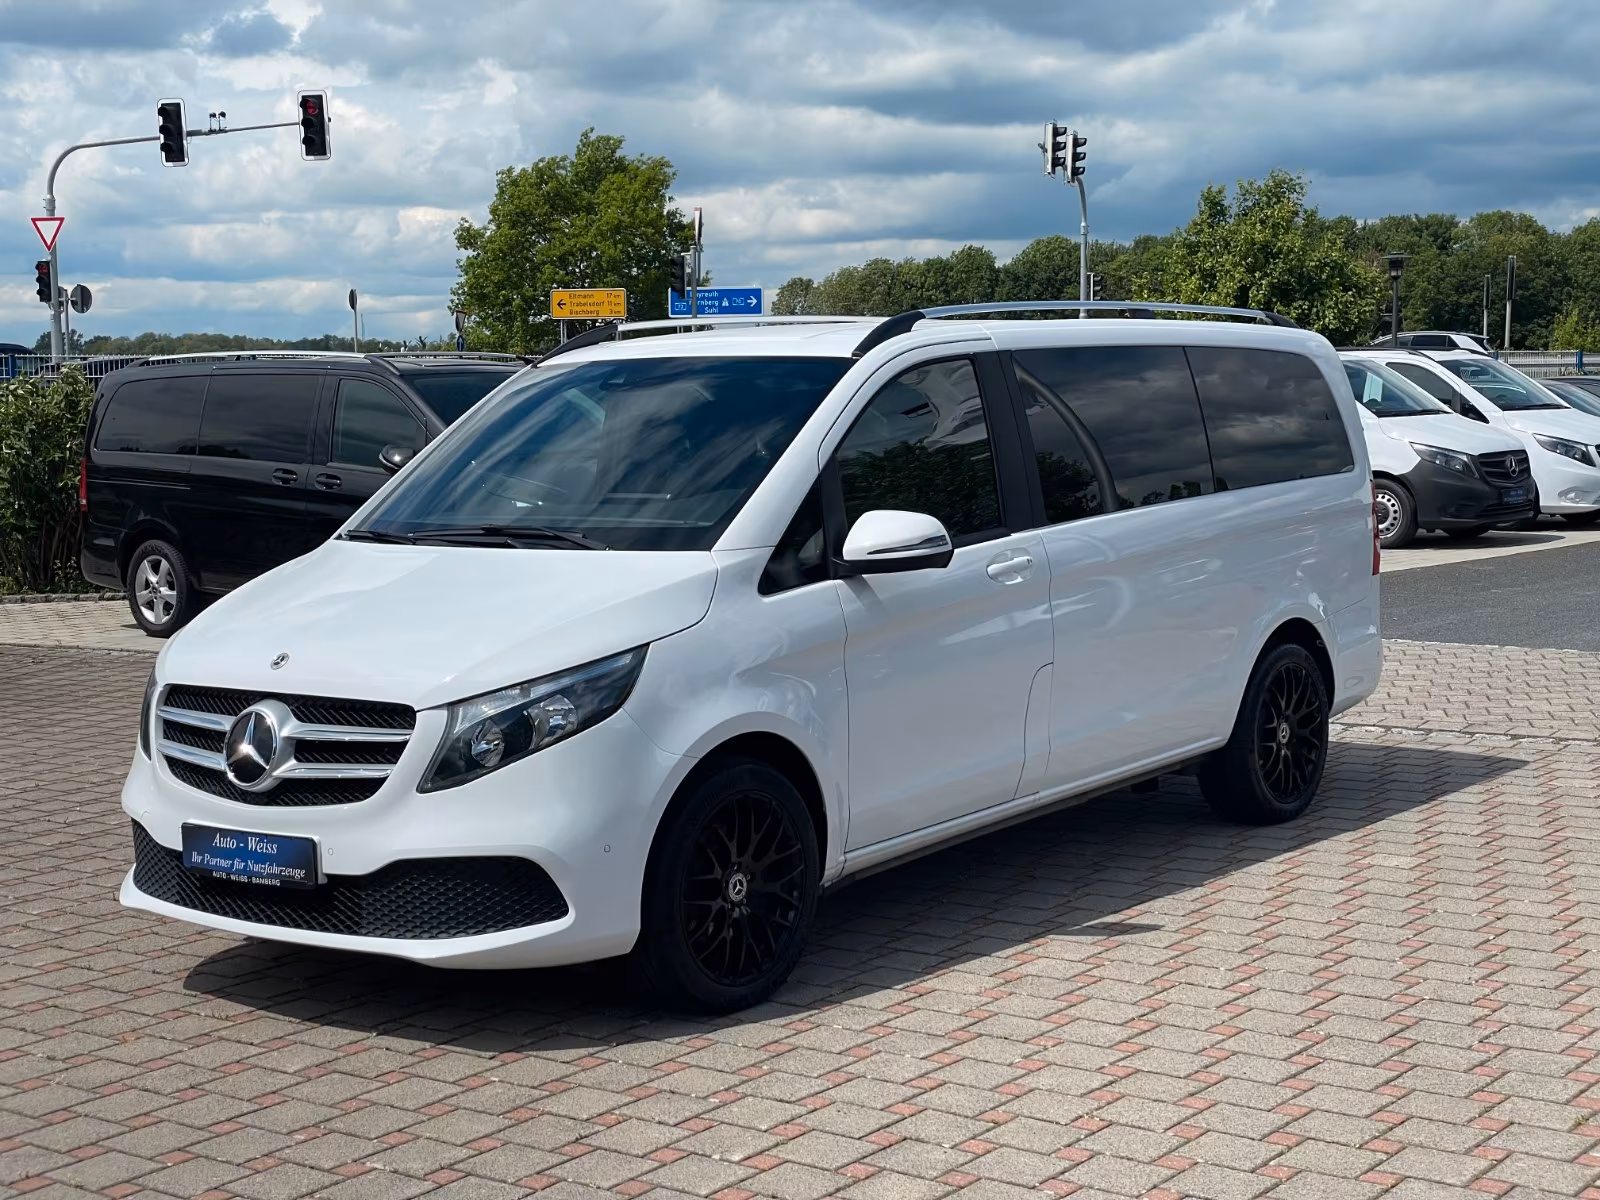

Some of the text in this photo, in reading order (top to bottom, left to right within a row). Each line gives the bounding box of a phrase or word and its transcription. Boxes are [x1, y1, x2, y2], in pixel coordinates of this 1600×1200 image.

[689, 290, 719, 298] yreuth
[689, 299, 719, 307] rnberg
[212, 832, 237, 849] Auto
[247, 836, 278, 854] Weiss
[191, 851, 306, 879] Ihr Partner für Nutzfahrzeuge
[212, 870, 227, 879] AUTO
[230, 874, 248, 883] WEISS
[251, 876, 281, 886] BAMBERG
